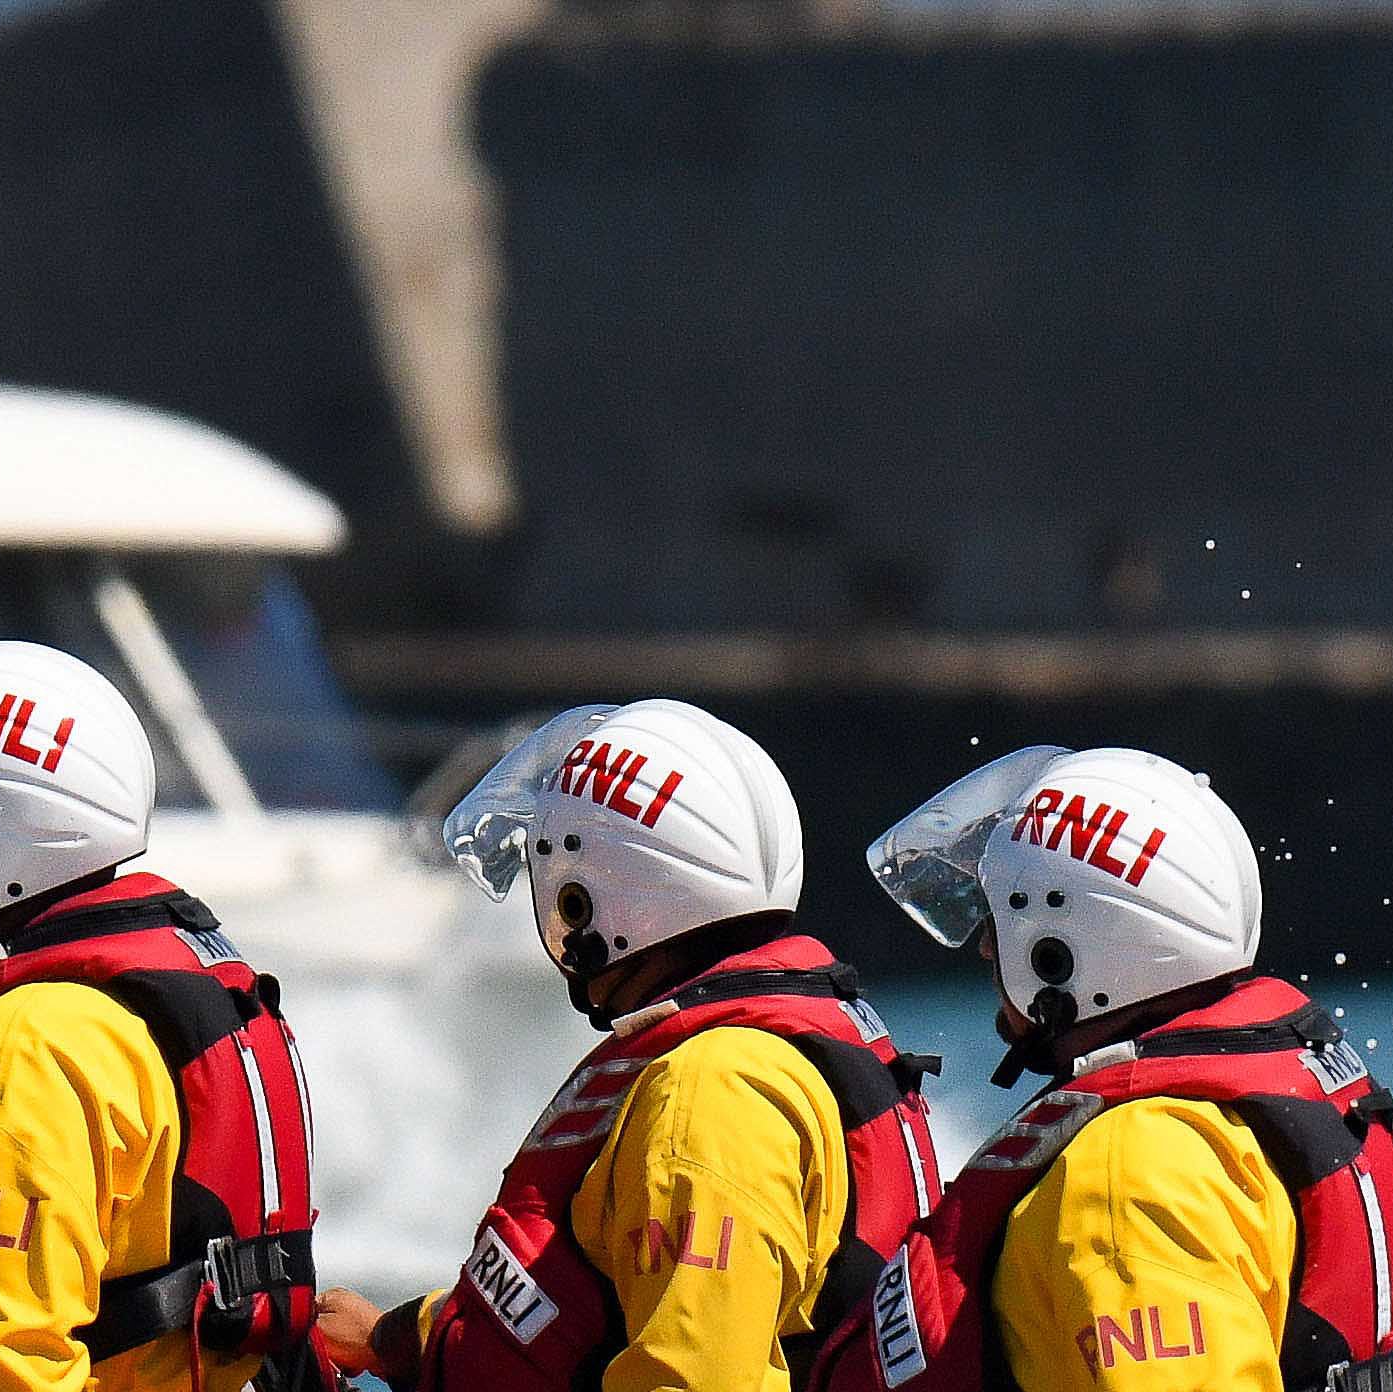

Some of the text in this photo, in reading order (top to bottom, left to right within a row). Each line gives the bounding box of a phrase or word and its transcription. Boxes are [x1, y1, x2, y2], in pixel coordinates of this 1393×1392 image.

[547, 740, 684, 829] RNLI
[1010, 788, 1167, 887] RNLI
[472, 1242, 542, 1327] RNLI
[876, 1266, 916, 1368] RNLI
